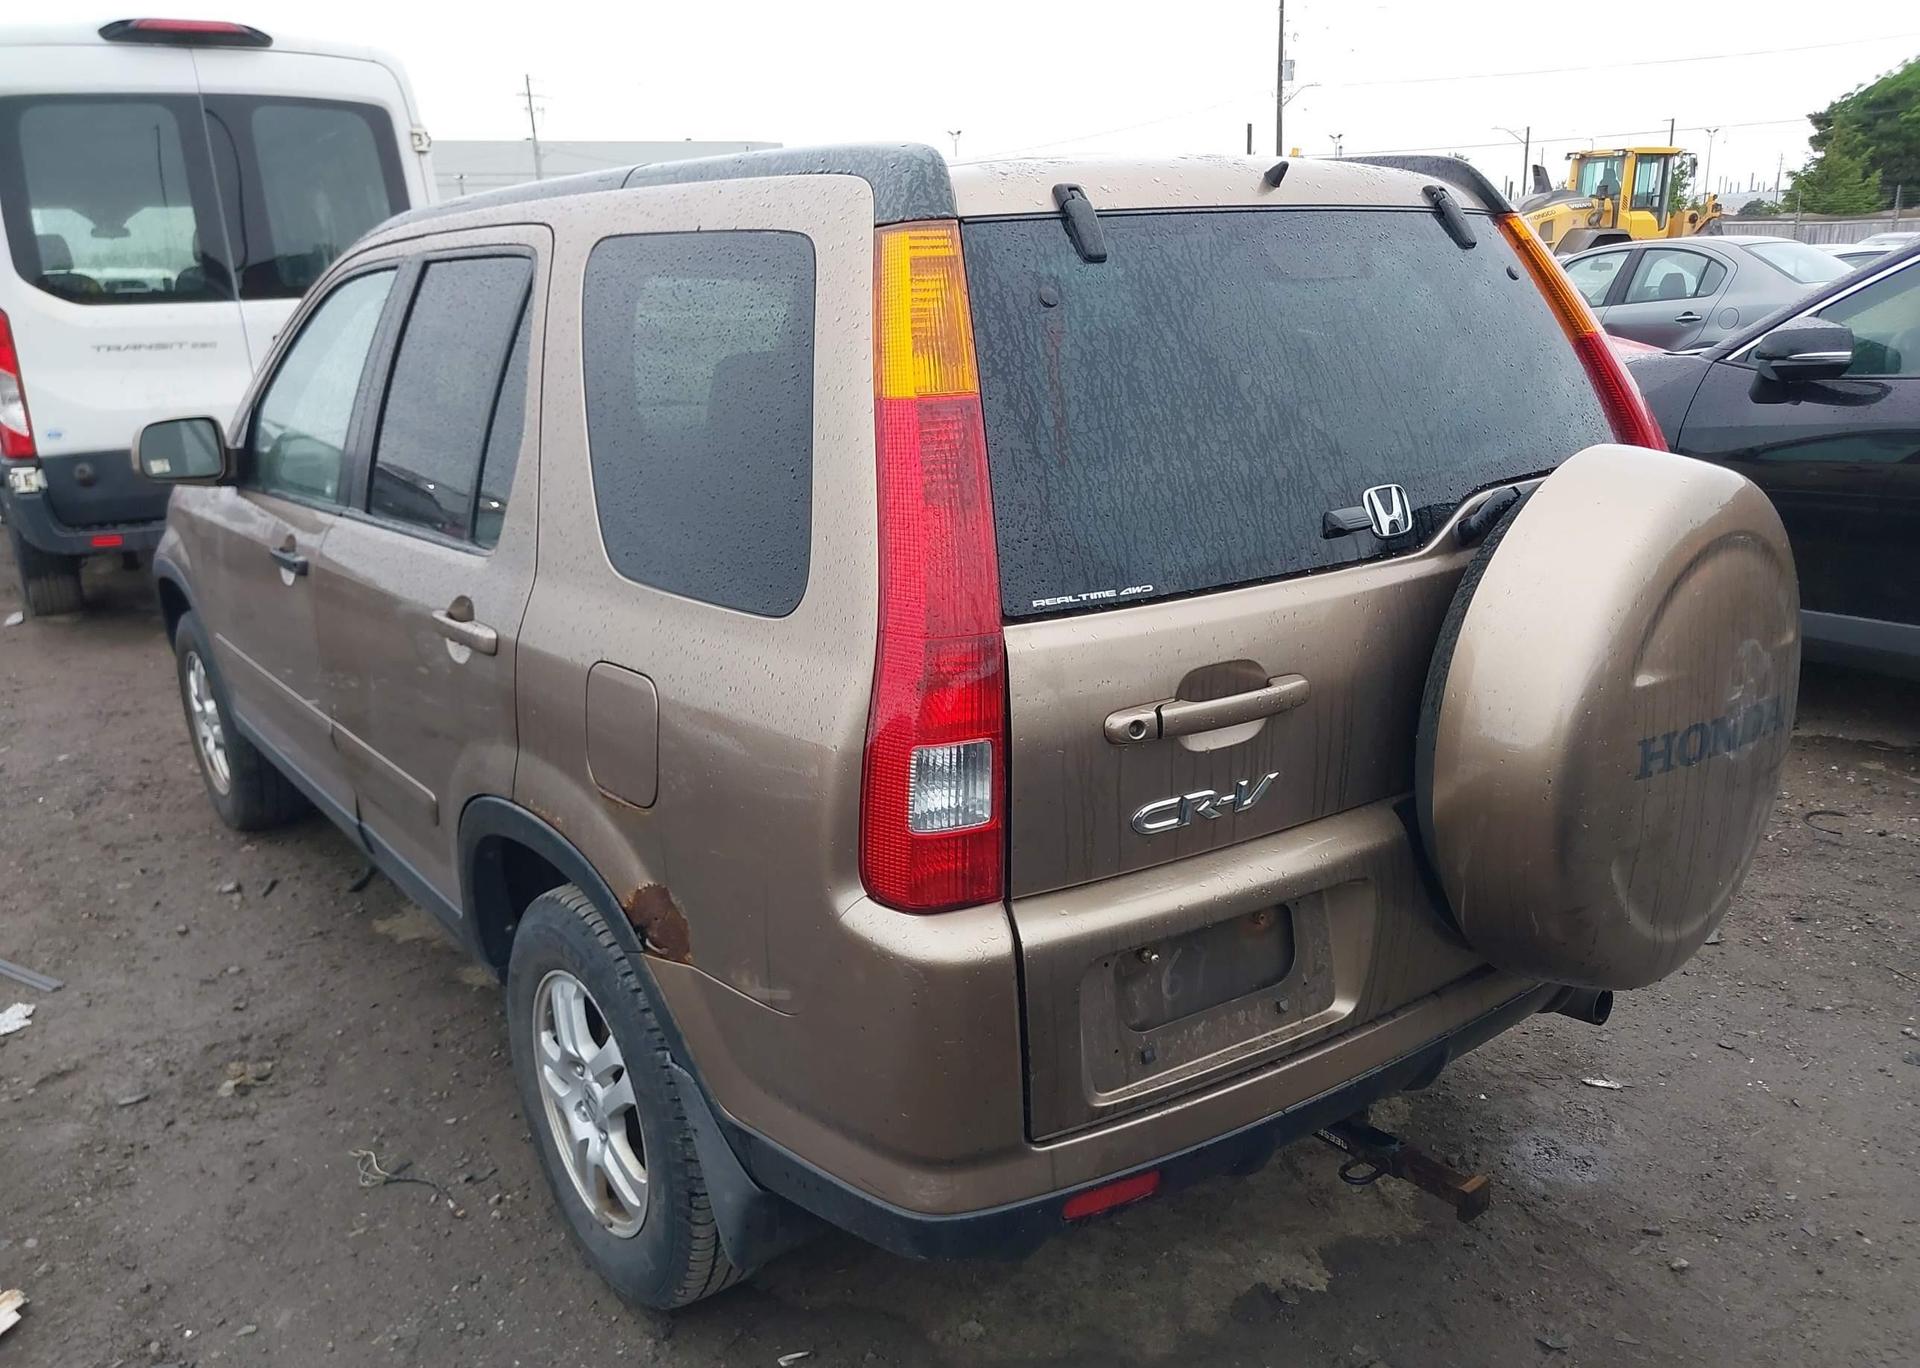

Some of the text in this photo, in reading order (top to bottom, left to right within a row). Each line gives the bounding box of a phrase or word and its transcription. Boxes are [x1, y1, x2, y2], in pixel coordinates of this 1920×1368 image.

[90, 341, 188, 352] TRANSIT
[1032, 584, 1154, 608] REALTIME 4WD
[1634, 696, 1785, 781] HONDA
[1131, 771, 1280, 835] CR-V
